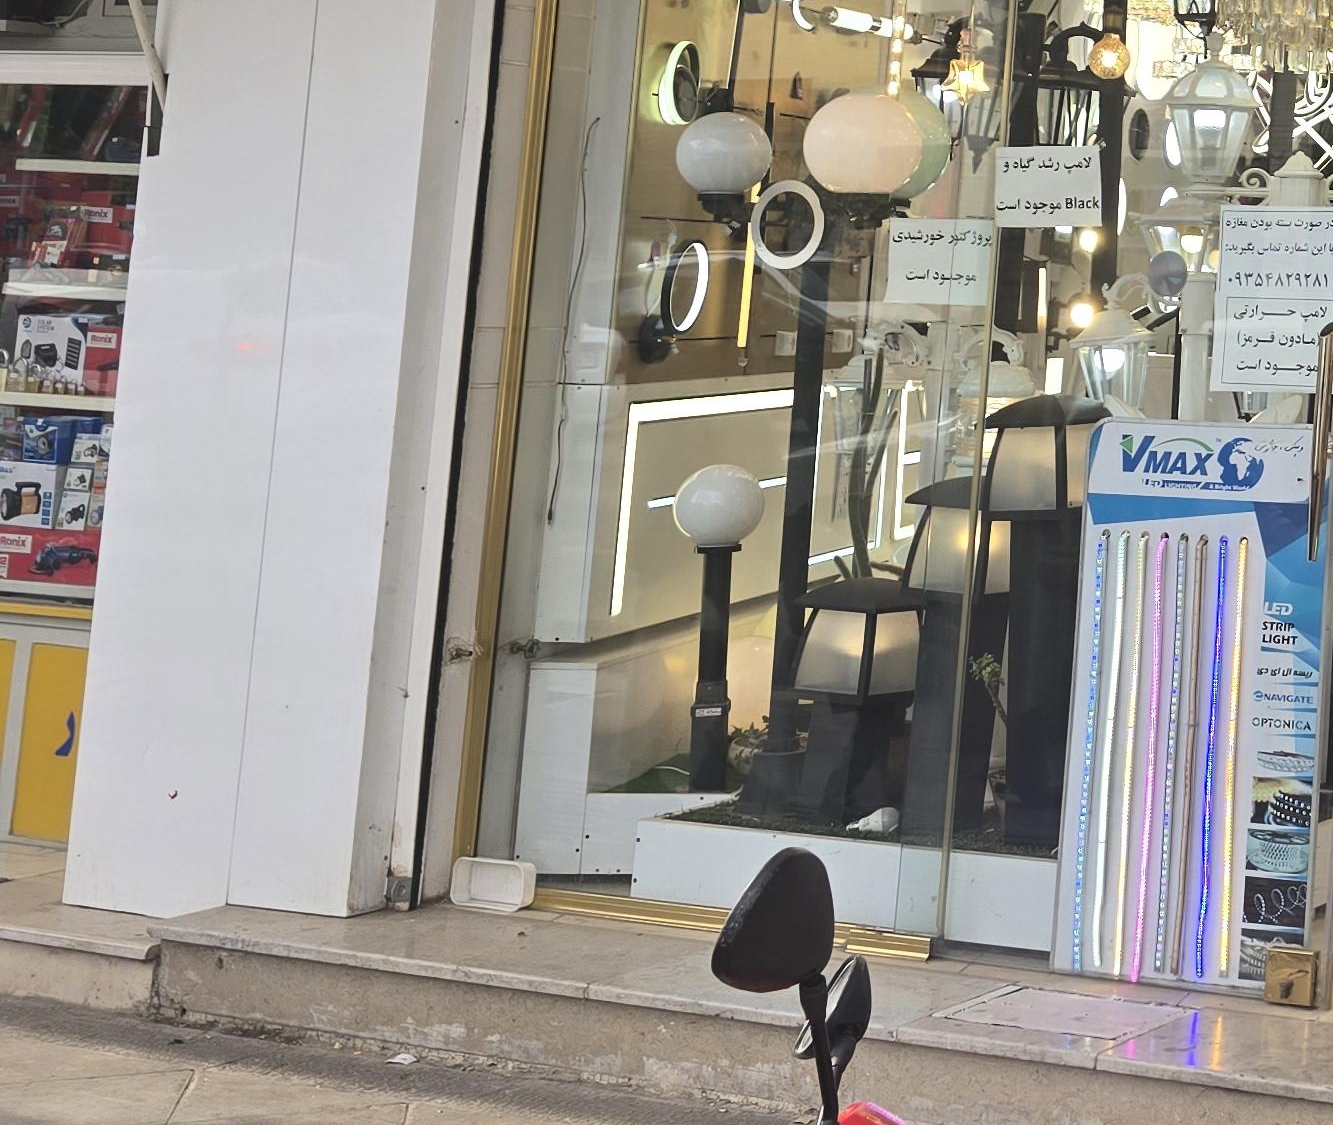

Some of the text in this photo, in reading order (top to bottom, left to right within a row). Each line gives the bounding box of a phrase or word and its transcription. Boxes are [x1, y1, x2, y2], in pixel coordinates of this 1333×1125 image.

[1004, 156, 1091, 174] لامپ رشد گیاه و
[996, 197, 1099, 214] Black موجود است
[84, 209, 109, 218] Ronix
[1225, 218, 1248, 228] مغازه
[1250, 219, 1272, 231] بودن
[1294, 220, 1322, 231] صورت
[893, 229, 944, 245] خورشیدی
[1257, 243, 1282, 255] تماس
[1284, 244, 1308, 254] شماره
[1311, 243, 1327, 255] این
[1329, 243, 1333, 255] با
[905, 270, 976, 285] موجود است
[1234, 304, 1328, 322] لامپ حرارتی
[91, 334, 113, 344] Ronix
[1236, 359, 1261, 371] است
[1120, 434, 1214, 476] VMAX
[0, 537, 26, 547] Ronix
[1265, 602, 1293, 615] LED
[1262, 621, 1295, 632] STRIP
[1262, 634, 1298, 645] LIGHT
[1294, 671, 1312, 679] ریسه
[1252, 717, 1312, 731] OPTONICA
